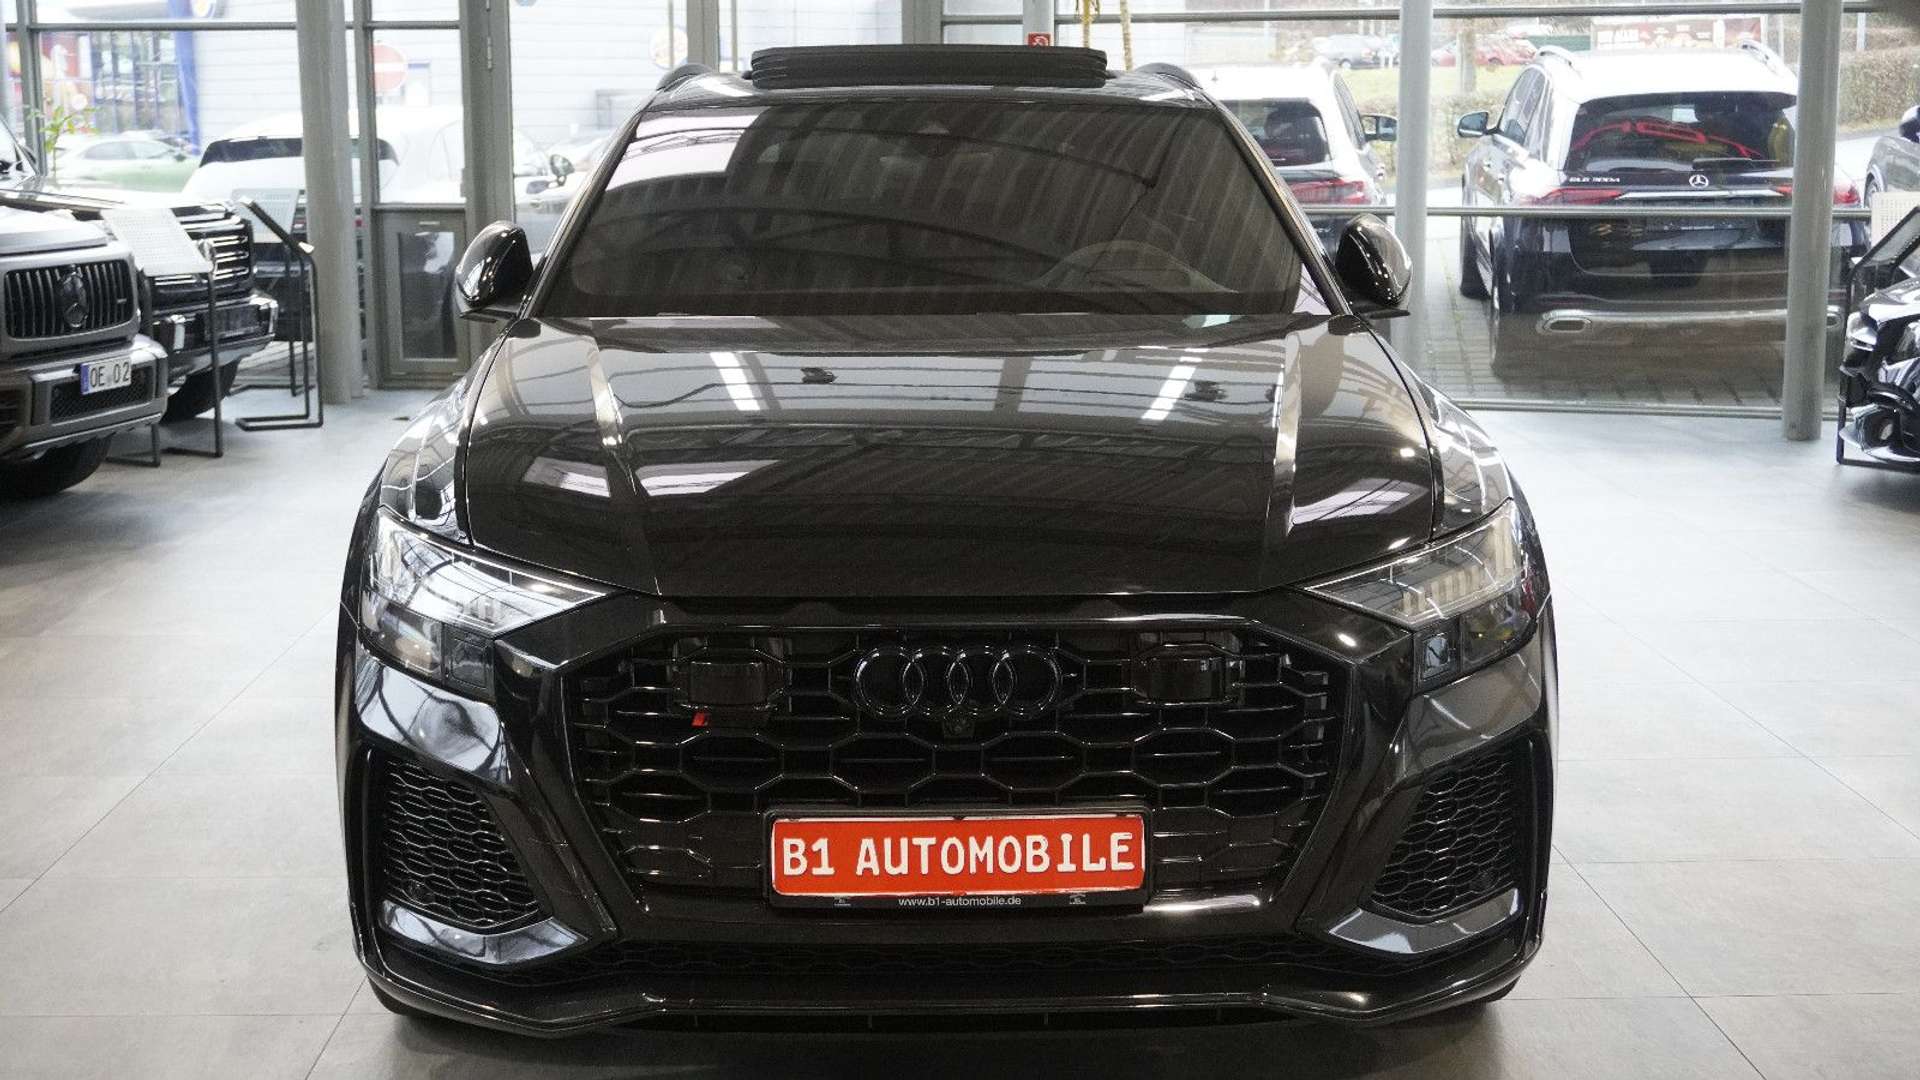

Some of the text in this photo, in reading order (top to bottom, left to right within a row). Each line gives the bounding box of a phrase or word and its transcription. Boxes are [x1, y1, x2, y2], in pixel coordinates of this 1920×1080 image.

[90, 361, 130, 388] OE 02
[782, 832, 1136, 876] B1 AUTOMOBILE
[898, 895, 1022, 908] www.b1-automobile.de
